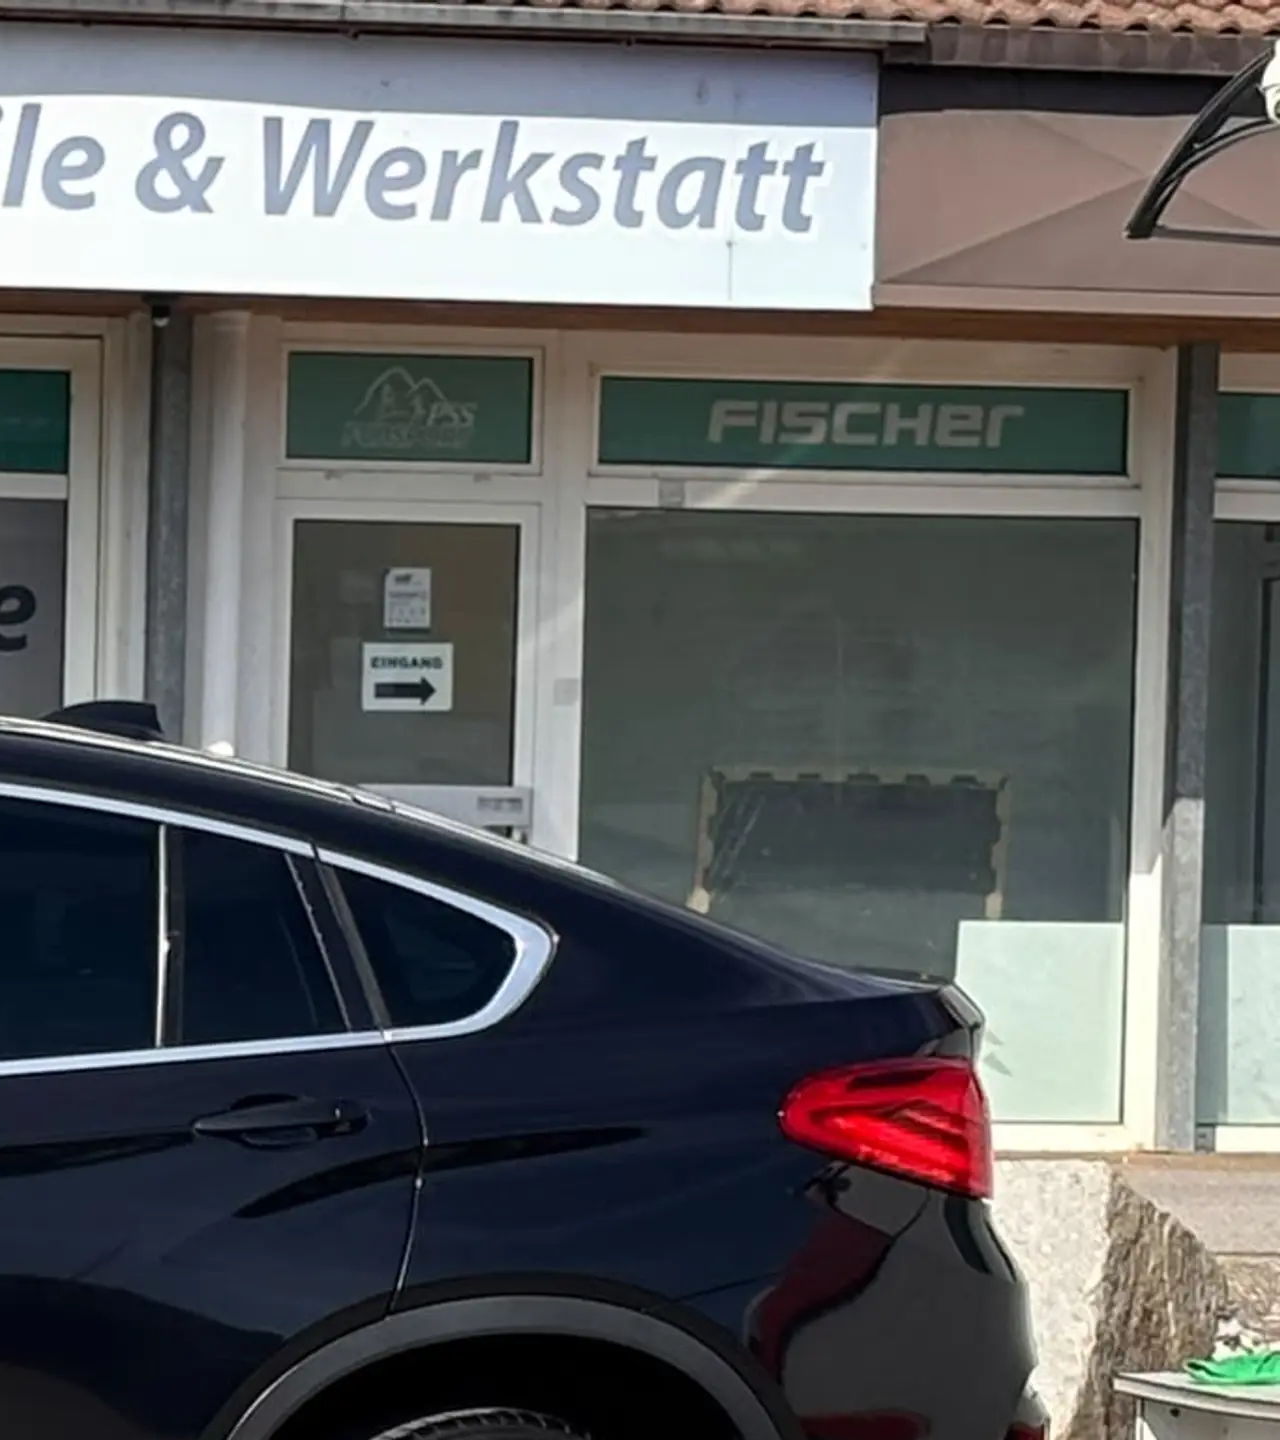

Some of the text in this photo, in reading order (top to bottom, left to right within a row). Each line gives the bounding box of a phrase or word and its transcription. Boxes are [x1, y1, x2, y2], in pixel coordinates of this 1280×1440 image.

[134, 111, 226, 214] &
[262, 115, 826, 234] Werkstatt
[370, 655, 444, 671] EINGANG
